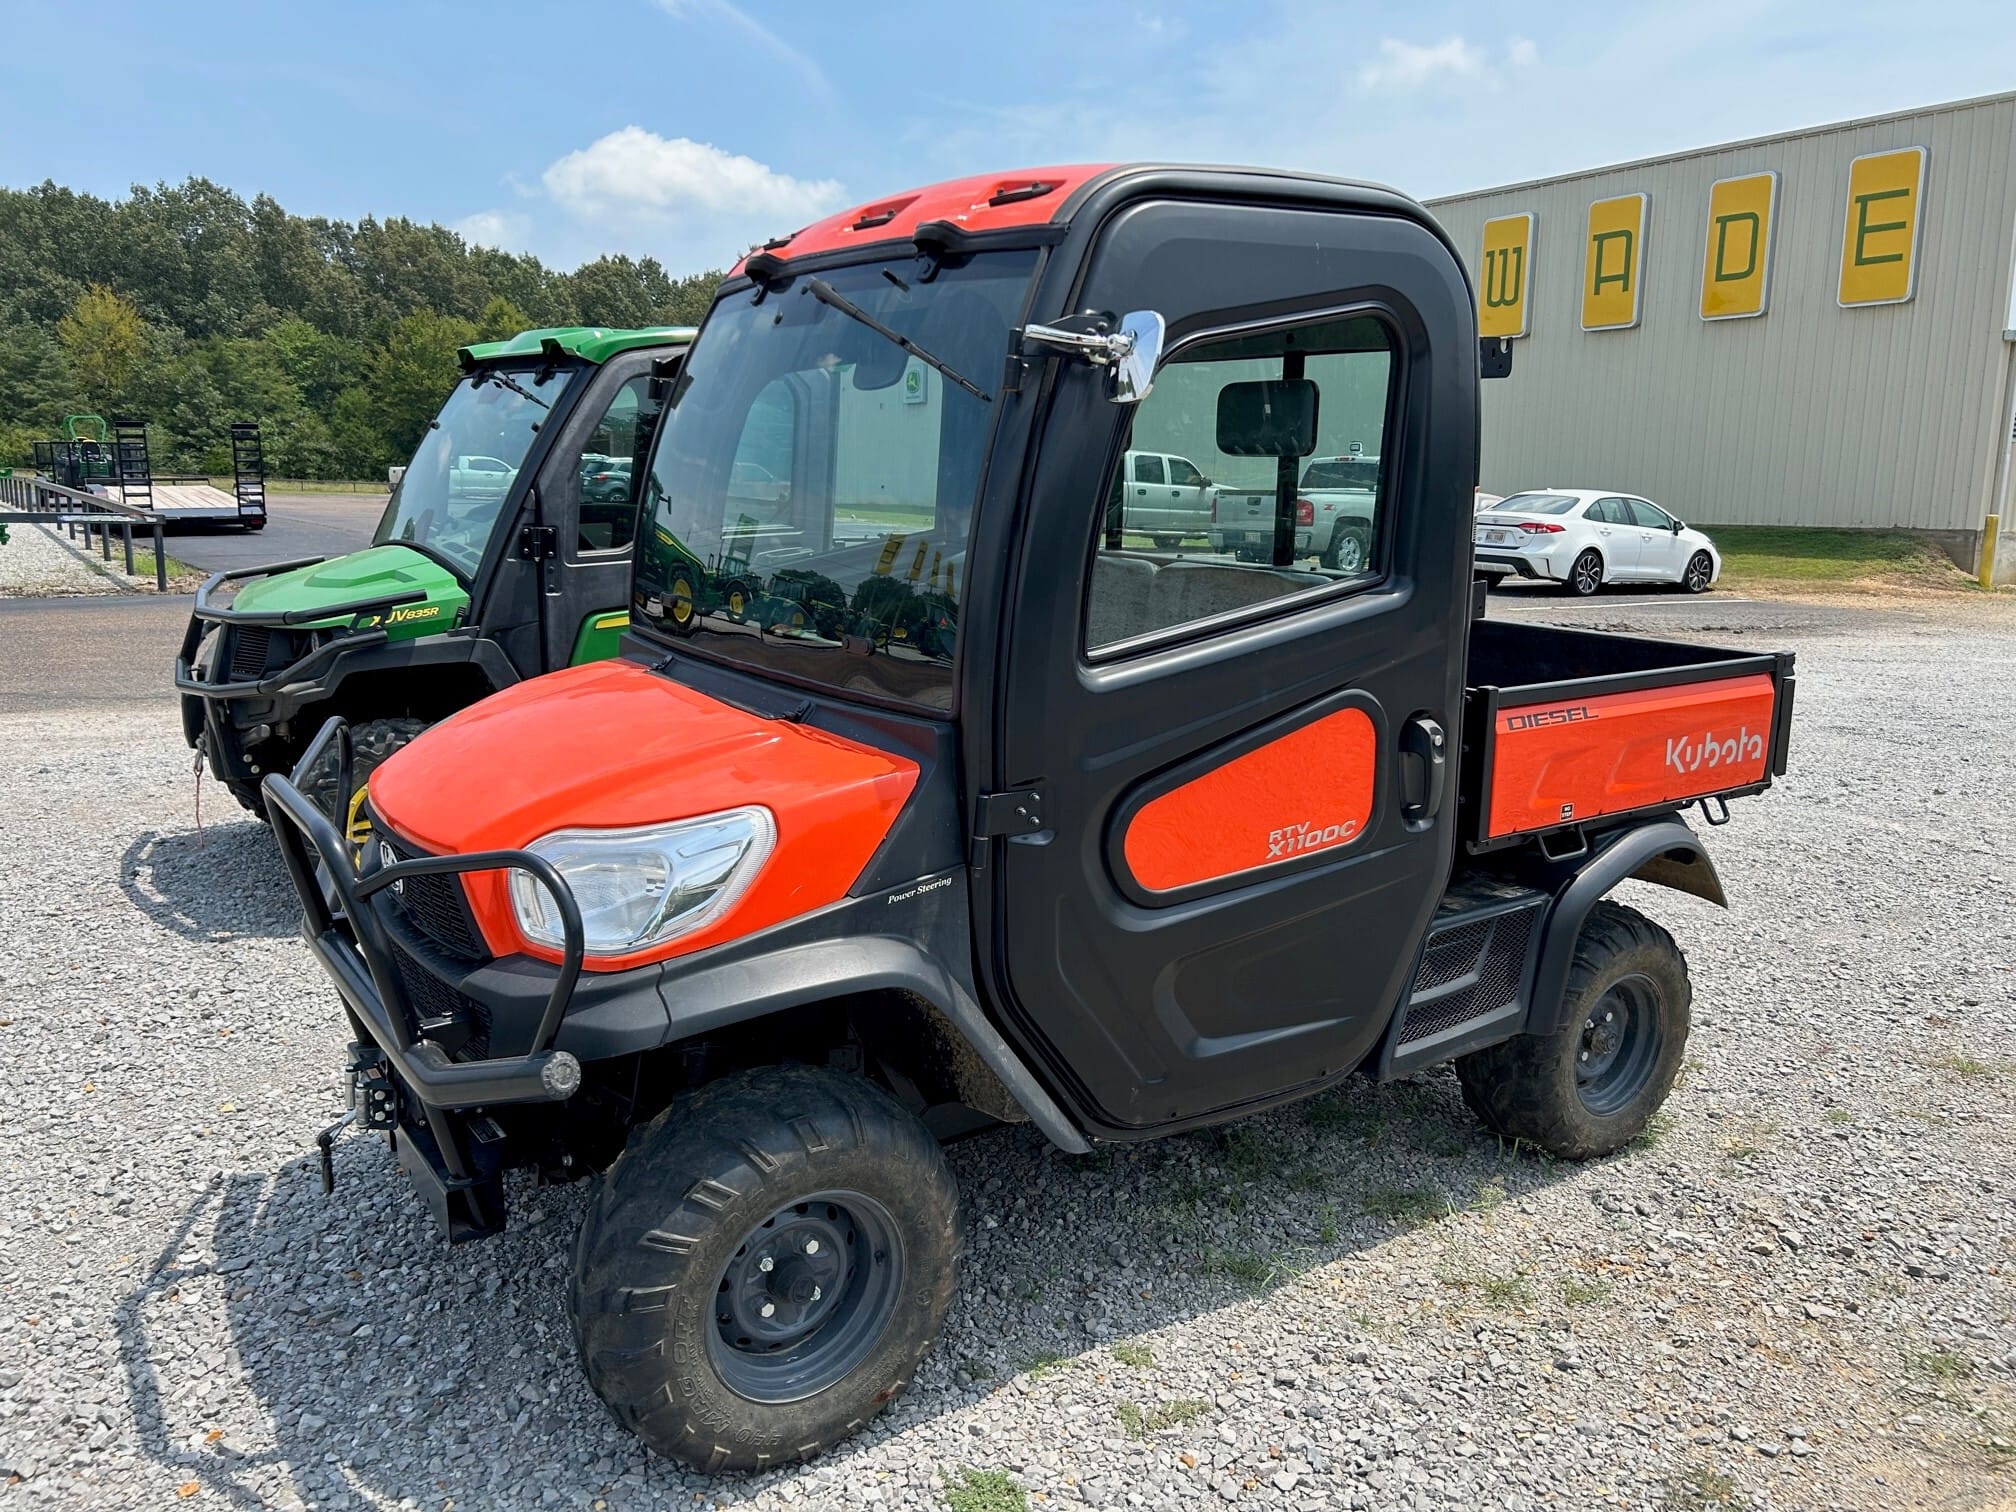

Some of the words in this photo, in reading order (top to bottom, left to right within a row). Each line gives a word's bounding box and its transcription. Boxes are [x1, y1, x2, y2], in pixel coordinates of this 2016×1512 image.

[1485, 188, 1910, 308] WADE
[1507, 706, 1599, 731] DIESEL
[1665, 726, 1763, 774] Kubota
[1265, 820, 1357, 859] X1100C
[1268, 821, 1311, 843] RTV
[887, 889, 917, 905] Power
[916, 877, 952, 895] Steering
